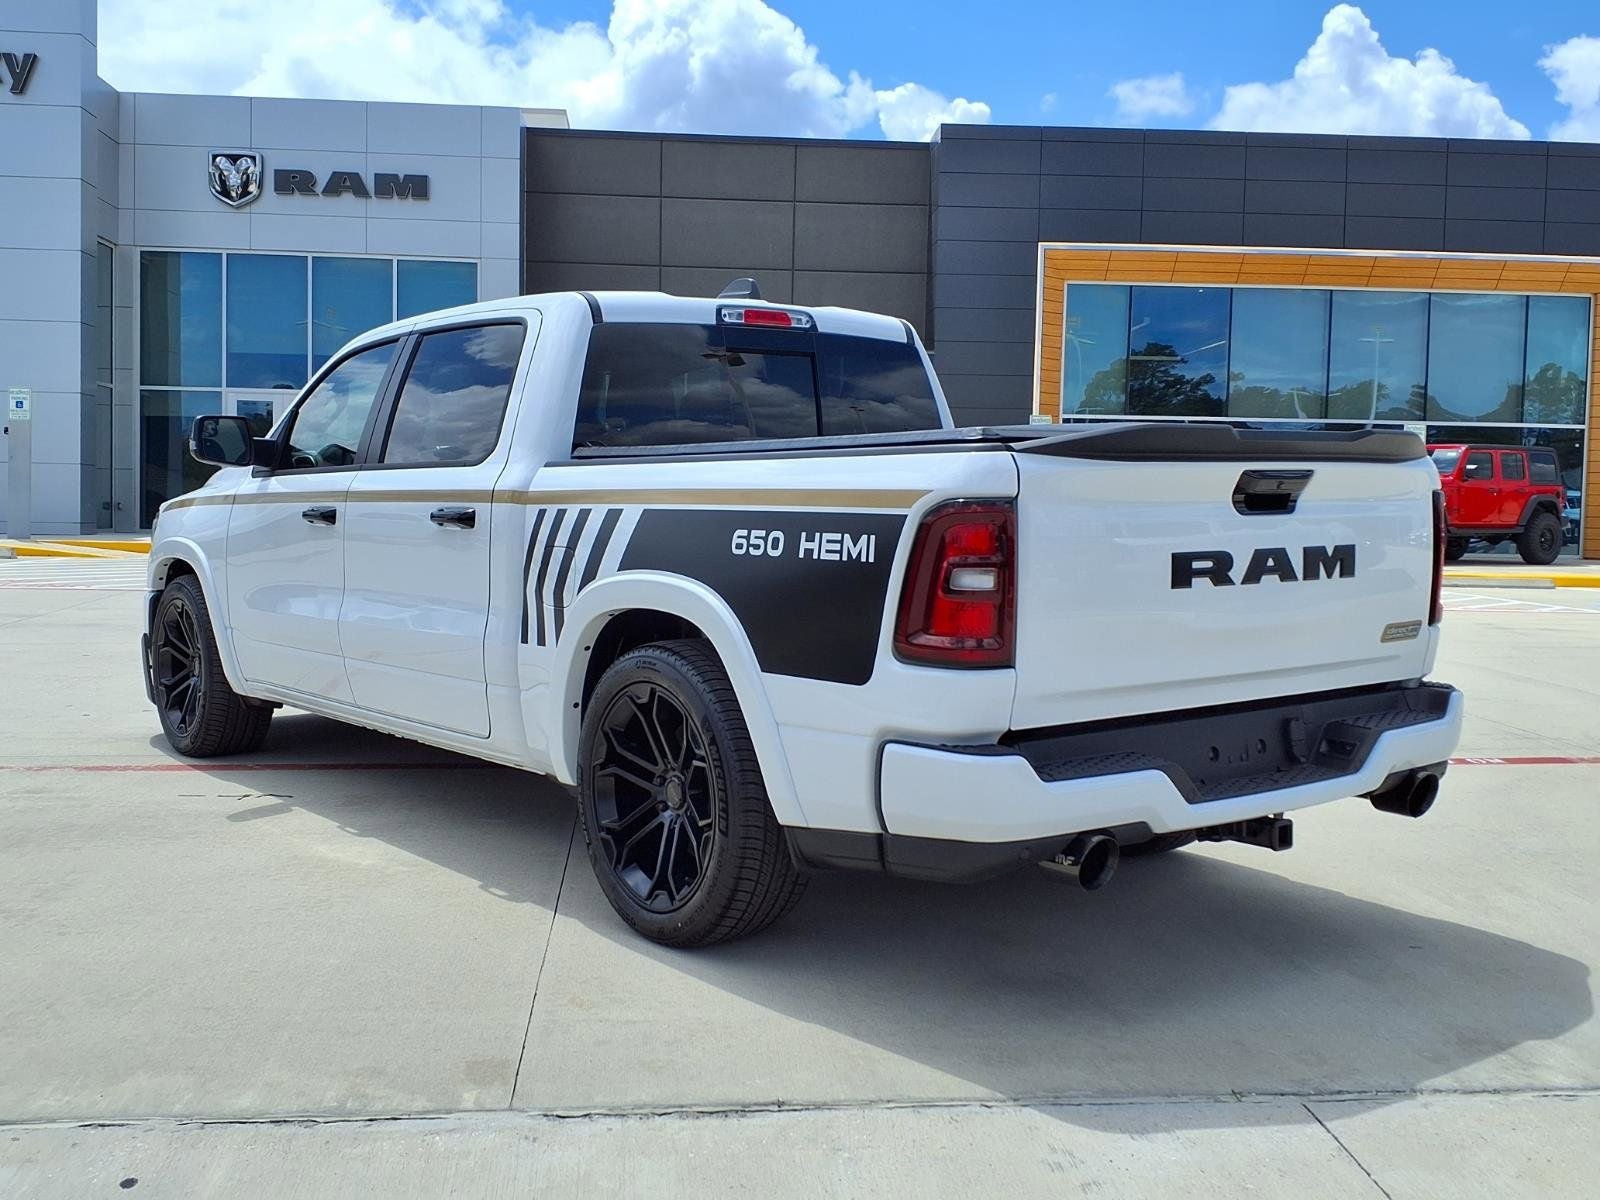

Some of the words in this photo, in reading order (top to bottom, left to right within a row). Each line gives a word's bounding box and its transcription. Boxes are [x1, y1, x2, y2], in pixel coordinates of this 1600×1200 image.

[273, 168, 430, 200] RAM
[731, 529, 785, 557] 650
[798, 531, 876, 563] HEMI
[1171, 543, 1356, 590] RAM
[709, 744, 728, 834] MICHELIN
